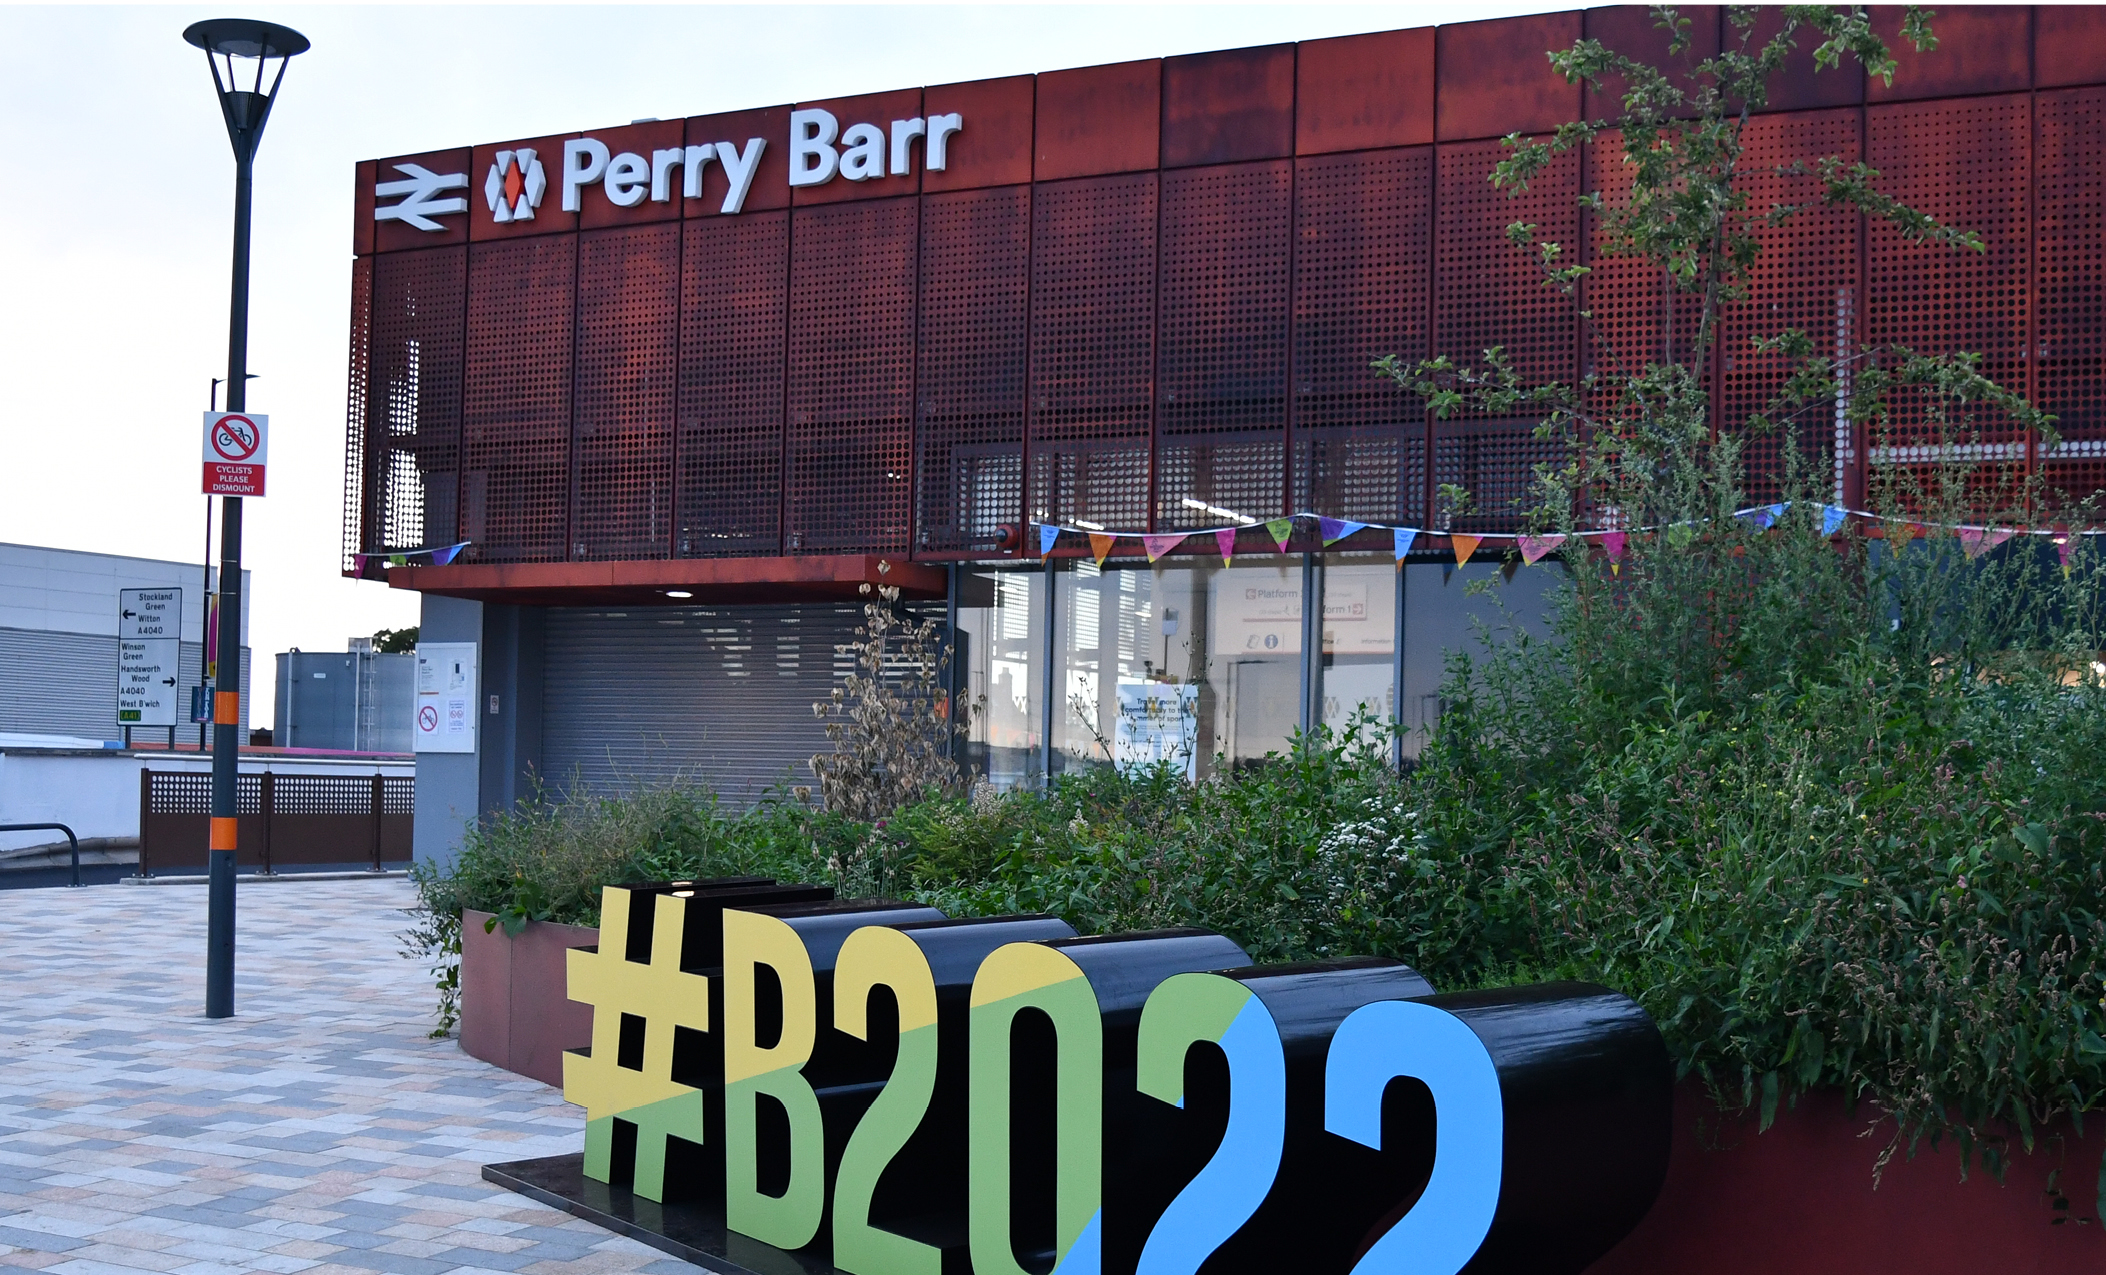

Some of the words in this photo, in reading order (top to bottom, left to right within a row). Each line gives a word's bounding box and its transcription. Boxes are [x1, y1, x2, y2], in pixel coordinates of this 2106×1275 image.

[562, 137, 767, 214] Perry
[789, 108, 963, 187] Barr
[216, 465, 252, 474] CYCLISTS
[219, 475, 249, 483] PLEASE
[212, 484, 255, 493] DISMOUNT
[139, 593, 173, 601] Stockland
[1258, 589, 1298, 598] Platform
[1323, 604, 1345, 613] form
[137, 626, 163, 634] A4040
[121, 643, 146, 651] Winson
[121, 665, 161, 673] Handsworth
[120, 687, 145, 695] A4040
[120, 710, 140, 720] (A41)
[562, 886, 1504, 1275] #B2022
